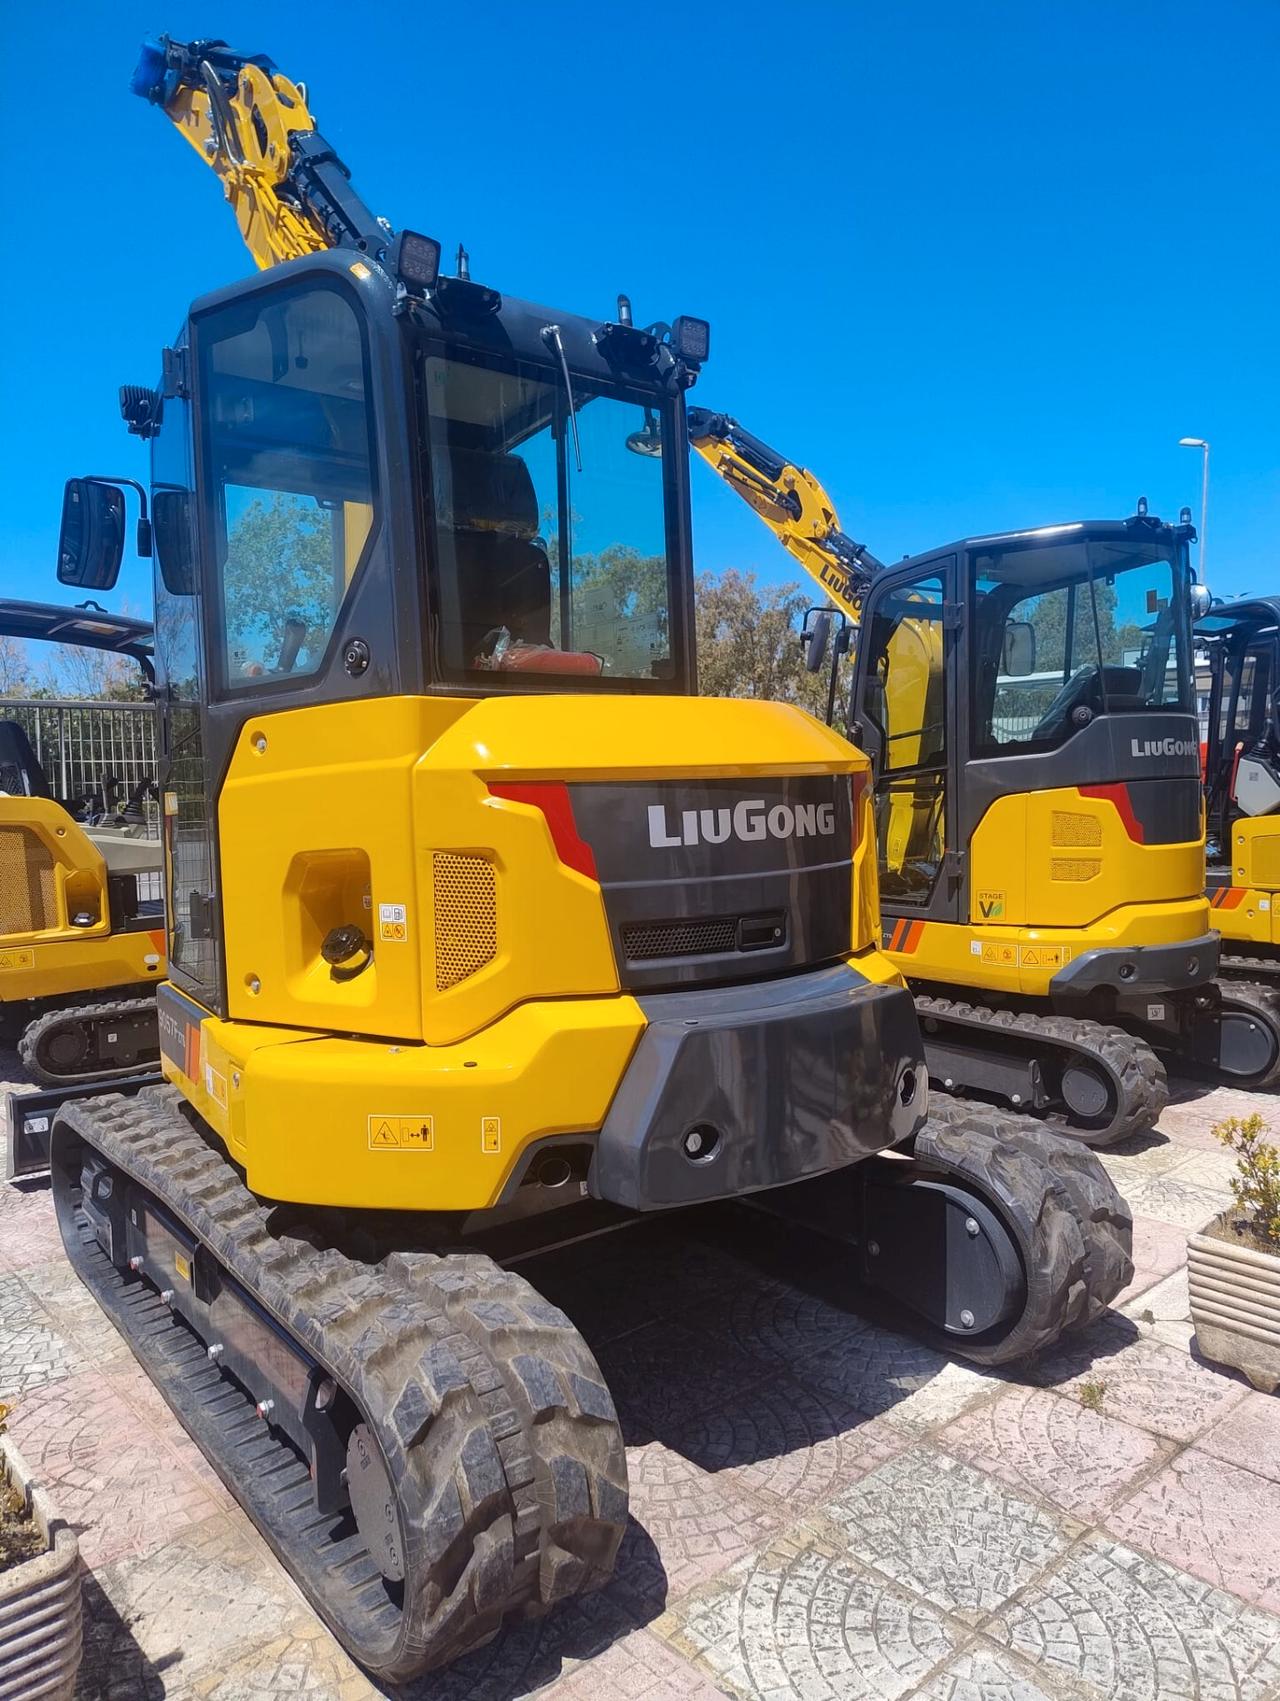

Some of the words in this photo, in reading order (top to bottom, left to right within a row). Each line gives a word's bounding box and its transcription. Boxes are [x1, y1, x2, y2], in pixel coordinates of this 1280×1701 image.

[820, 564, 863, 619] LIUGO
[648, 800, 835, 848] LIUGONG
[979, 901, 994, 918] V
